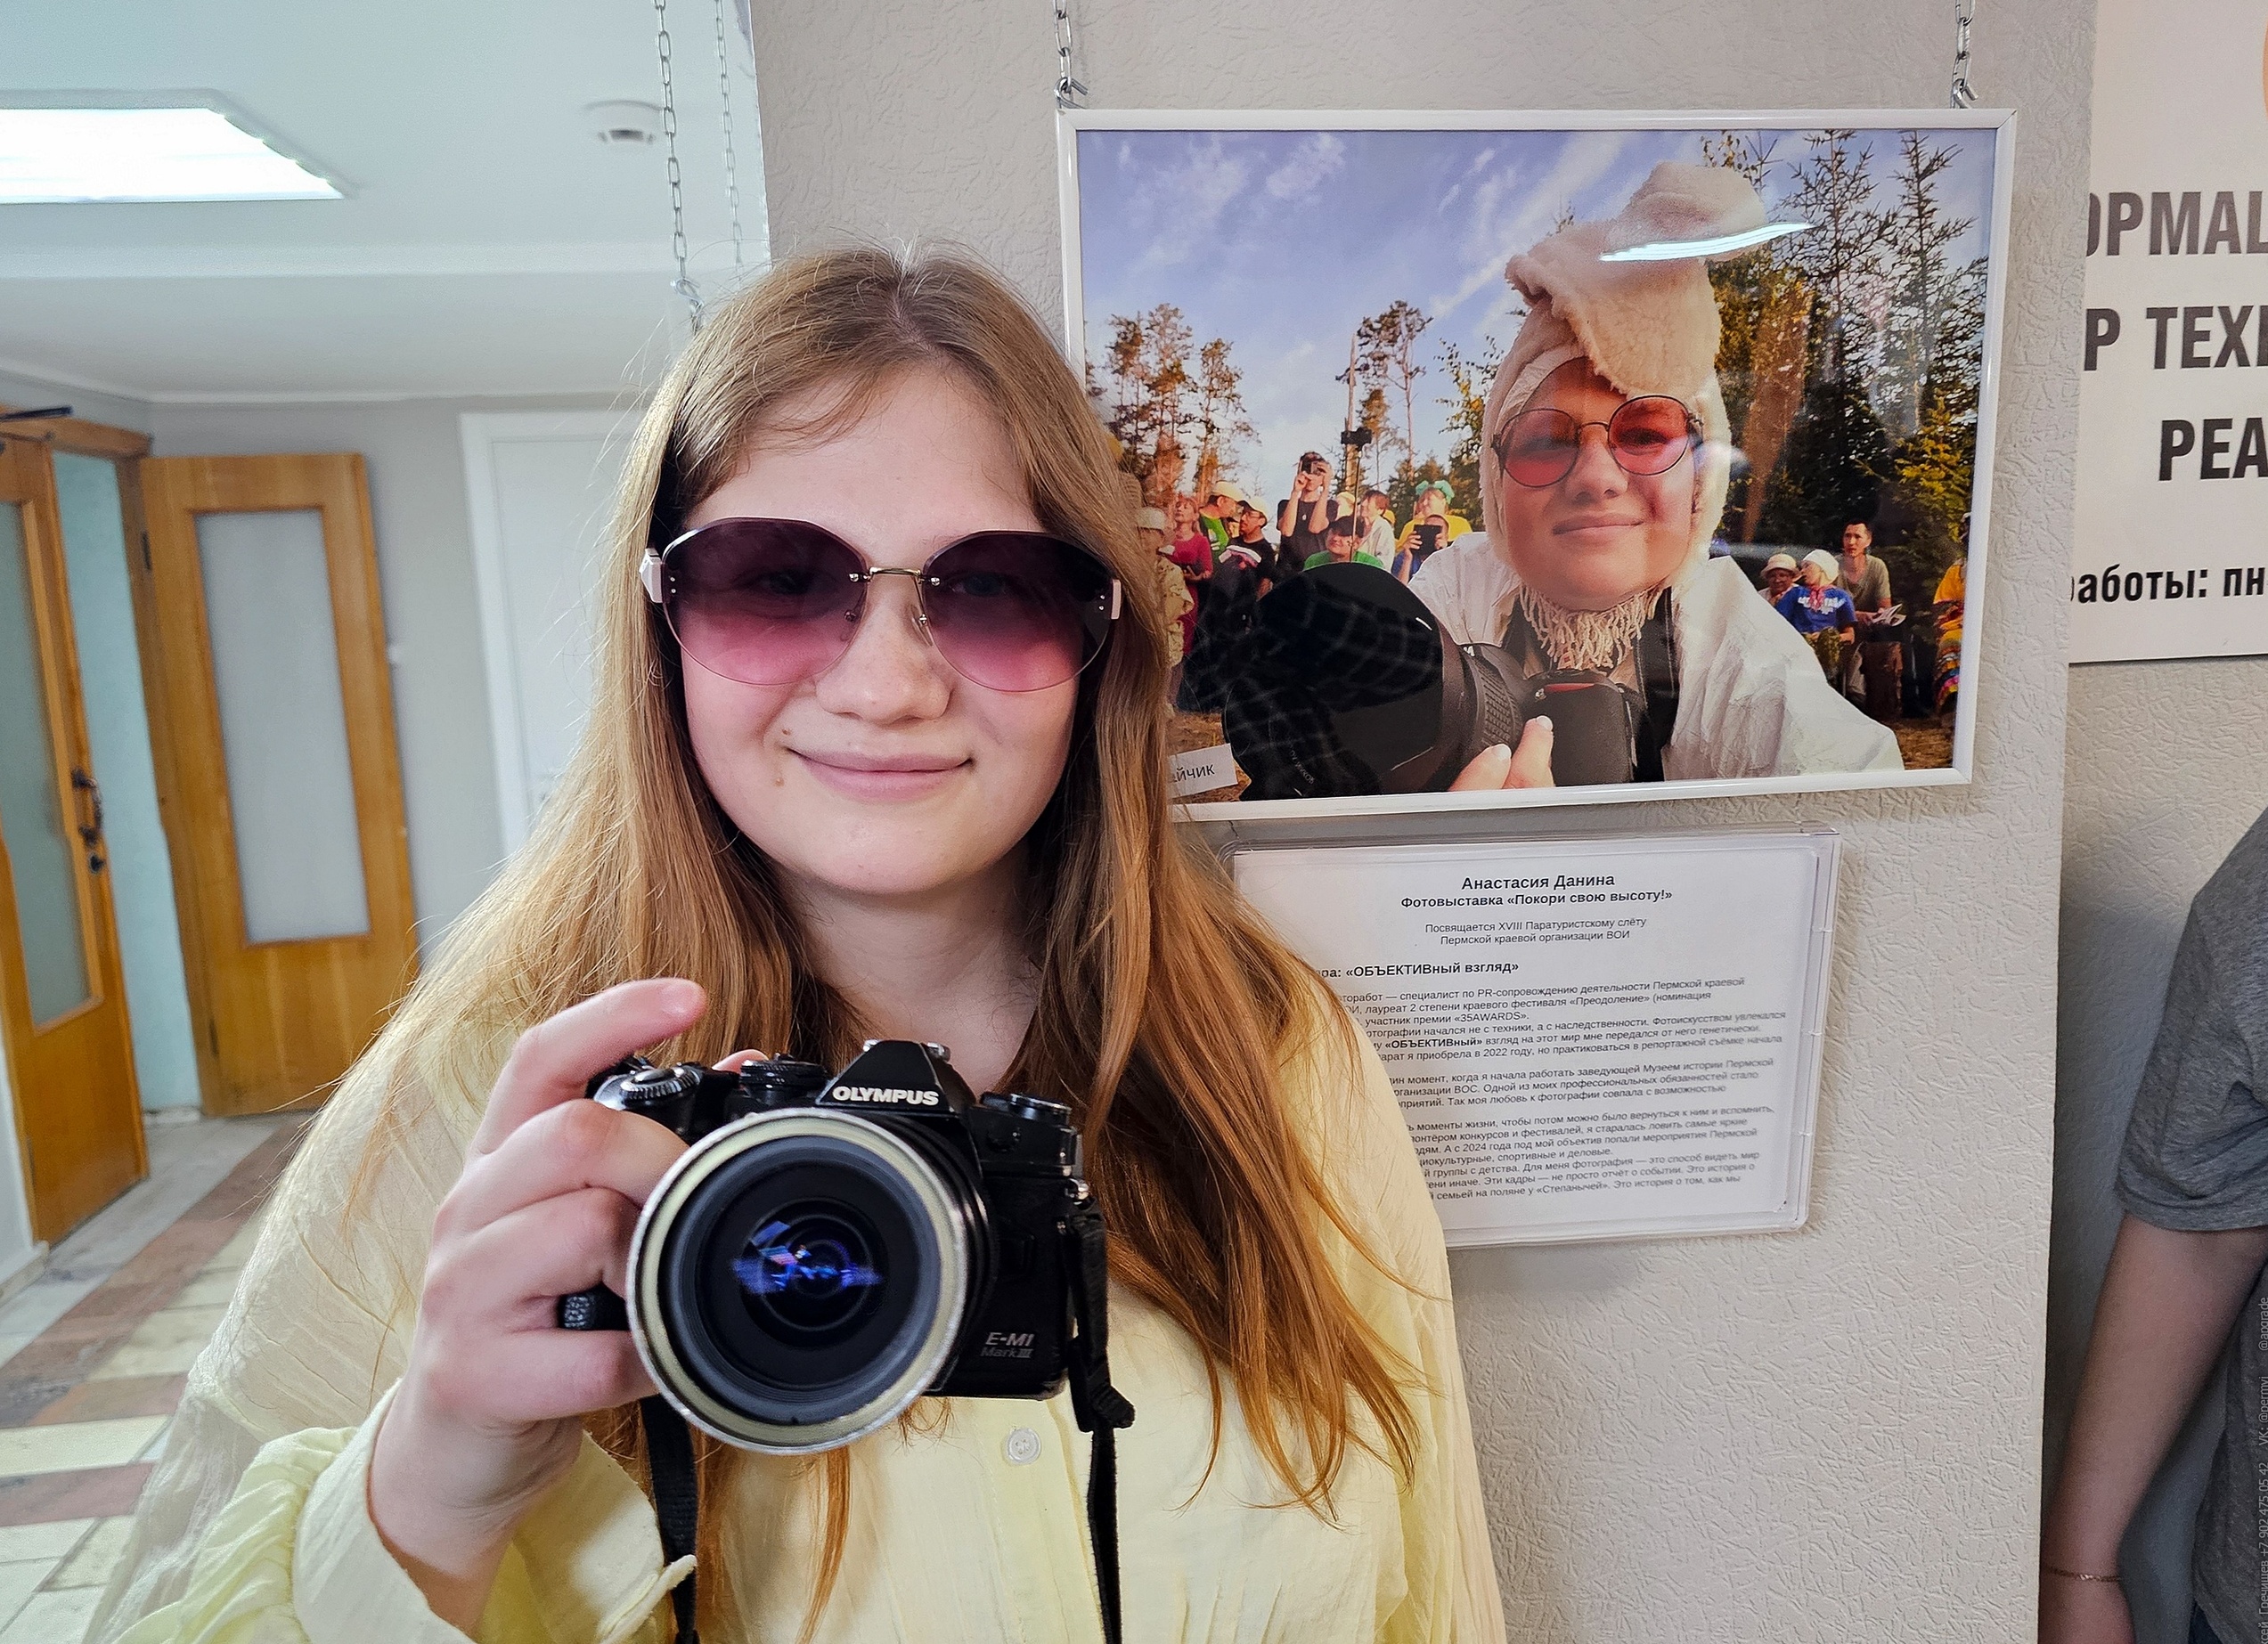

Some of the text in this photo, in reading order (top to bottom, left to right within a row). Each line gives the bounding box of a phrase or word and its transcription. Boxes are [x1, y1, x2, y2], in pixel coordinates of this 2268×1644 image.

[2071, 564, 2207, 603] аботы:
[1461, 875, 1615, 891] Анастасия Данина
[1400, 896, 1504, 908] Фотовыставка
[1506, 894, 1565, 907] «Покори
[1569, 893, 1606, 903] свою
[1424, 924, 1495, 934] Посвящается
[1497, 921, 1522, 932] XVIII
[1525, 920, 1615, 932] Паратуристскому
[1440, 930, 1629, 947] Пермской краевой организации ВОИ
[1345, 962, 1460, 977] «ОБЪЕКТИВный
[1464, 963, 1519, 974] взгляд»
[1340, 993, 1383, 1004] торабот
[1399, 990, 1459, 1002] специалист
[1462, 990, 1474, 998] по
[1477, 987, 1578, 998] PR-сопровождению
[1579, 983, 1650, 996] деятельности
[1364, 1005, 1407, 1016] лауреат
[1409, 1003, 1416, 1013] 2
[1418, 1003, 1460, 1013] степени
[1462, 1001, 1508, 1013] краевого
[1510, 998, 1567, 1011] фестиваля
[1569, 995, 1650, 1007] «Преодоление»
[1364, 1017, 1411, 1029] участник
[1413, 1015, 1451, 1026] премии
[1366, 1027, 1421, 1039] отографии
[1423, 1027, 1466, 1036] начался
[1468, 1026, 1481, 1034] не
[1384, 1037, 1482, 1049] «ОБЪЕКТИВный»
[1485, 1037, 1519, 1046] взгляд
[1521, 1036, 1534, 1044] на
[1535, 1035, 1558, 1043] этот
[1561, 1034, 1580, 1044] мир
[1582, 1033, 1603, 1041] мне
[1377, 1053, 1405, 1063] арат
[1415, 1050, 1472, 1062] приобрела
[1482, 1047, 1507, 1057] 2022
[1538, 1046, 1550, 1054] но
[1552, 1043, 1630, 1056] практиковаться
[1451, 1074, 1479, 1084] когда
[1489, 1071, 1527, 1081] начала
[1529, 1069, 1575, 1081] работать
[1577, 1064, 1640, 1078] заведующей
[1393, 1087, 1451, 1097] организации
[1482, 1081, 1516, 1095] Одной
[1518, 1083, 1530, 1091] из
[1532, 1082, 1557, 1090] моих
[1559, 1077, 1657, 1090] профессиональных
[832, 1086, 940, 1106] OLYMPUS
[1447, 1097, 1465, 1106] Так
[1467, 1097, 1487, 1105] моя
[1489, 1094, 1528, 1104] любовь
[1537, 1090, 1600, 1103] фотографии
[1602, 1089, 1644, 1099] совпала
[1416, 1121, 1463, 1131] моменты
[1501, 1117, 1531, 1127] чтобы
[1533, 1116, 1563, 1125] потом
[1566, 1114, 1599, 1123] можно
[1601, 1112, 1628, 1122] было
[1459, 1131, 1509, 1142] конкурсов
[1595, 1124, 1646, 1134] старалась
[1462, 1143, 1487, 1152] 2024
[1489, 1143, 1512, 1152] года
[1513, 1141, 1532, 1151] под
[1534, 1138, 1554, 1148] мой
[1556, 1137, 1602, 1147] объектив
[1604, 1135, 1640, 1144] попали
[1497, 1152, 1556, 1163] спортивные
[1432, 1168, 1468, 1179] группы
[1522, 1163, 1542, 1174] Для
[1545, 1162, 1570, 1170] меня
[1571, 1157, 1633, 1170] фотография
[1483, 1176, 1502, 1185] Эти
[1505, 1176, 1536, 1185] кадры
[1551, 1174, 1563, 1182] не
[1565, 1171, 1600, 1183] просто
[1436, 1189, 1473, 1200] семьей
[1475, 1190, 1488, 1198] на
[1489, 1187, 1526, 1196] поляне
[1612, 1180, 1632, 1189] Это
